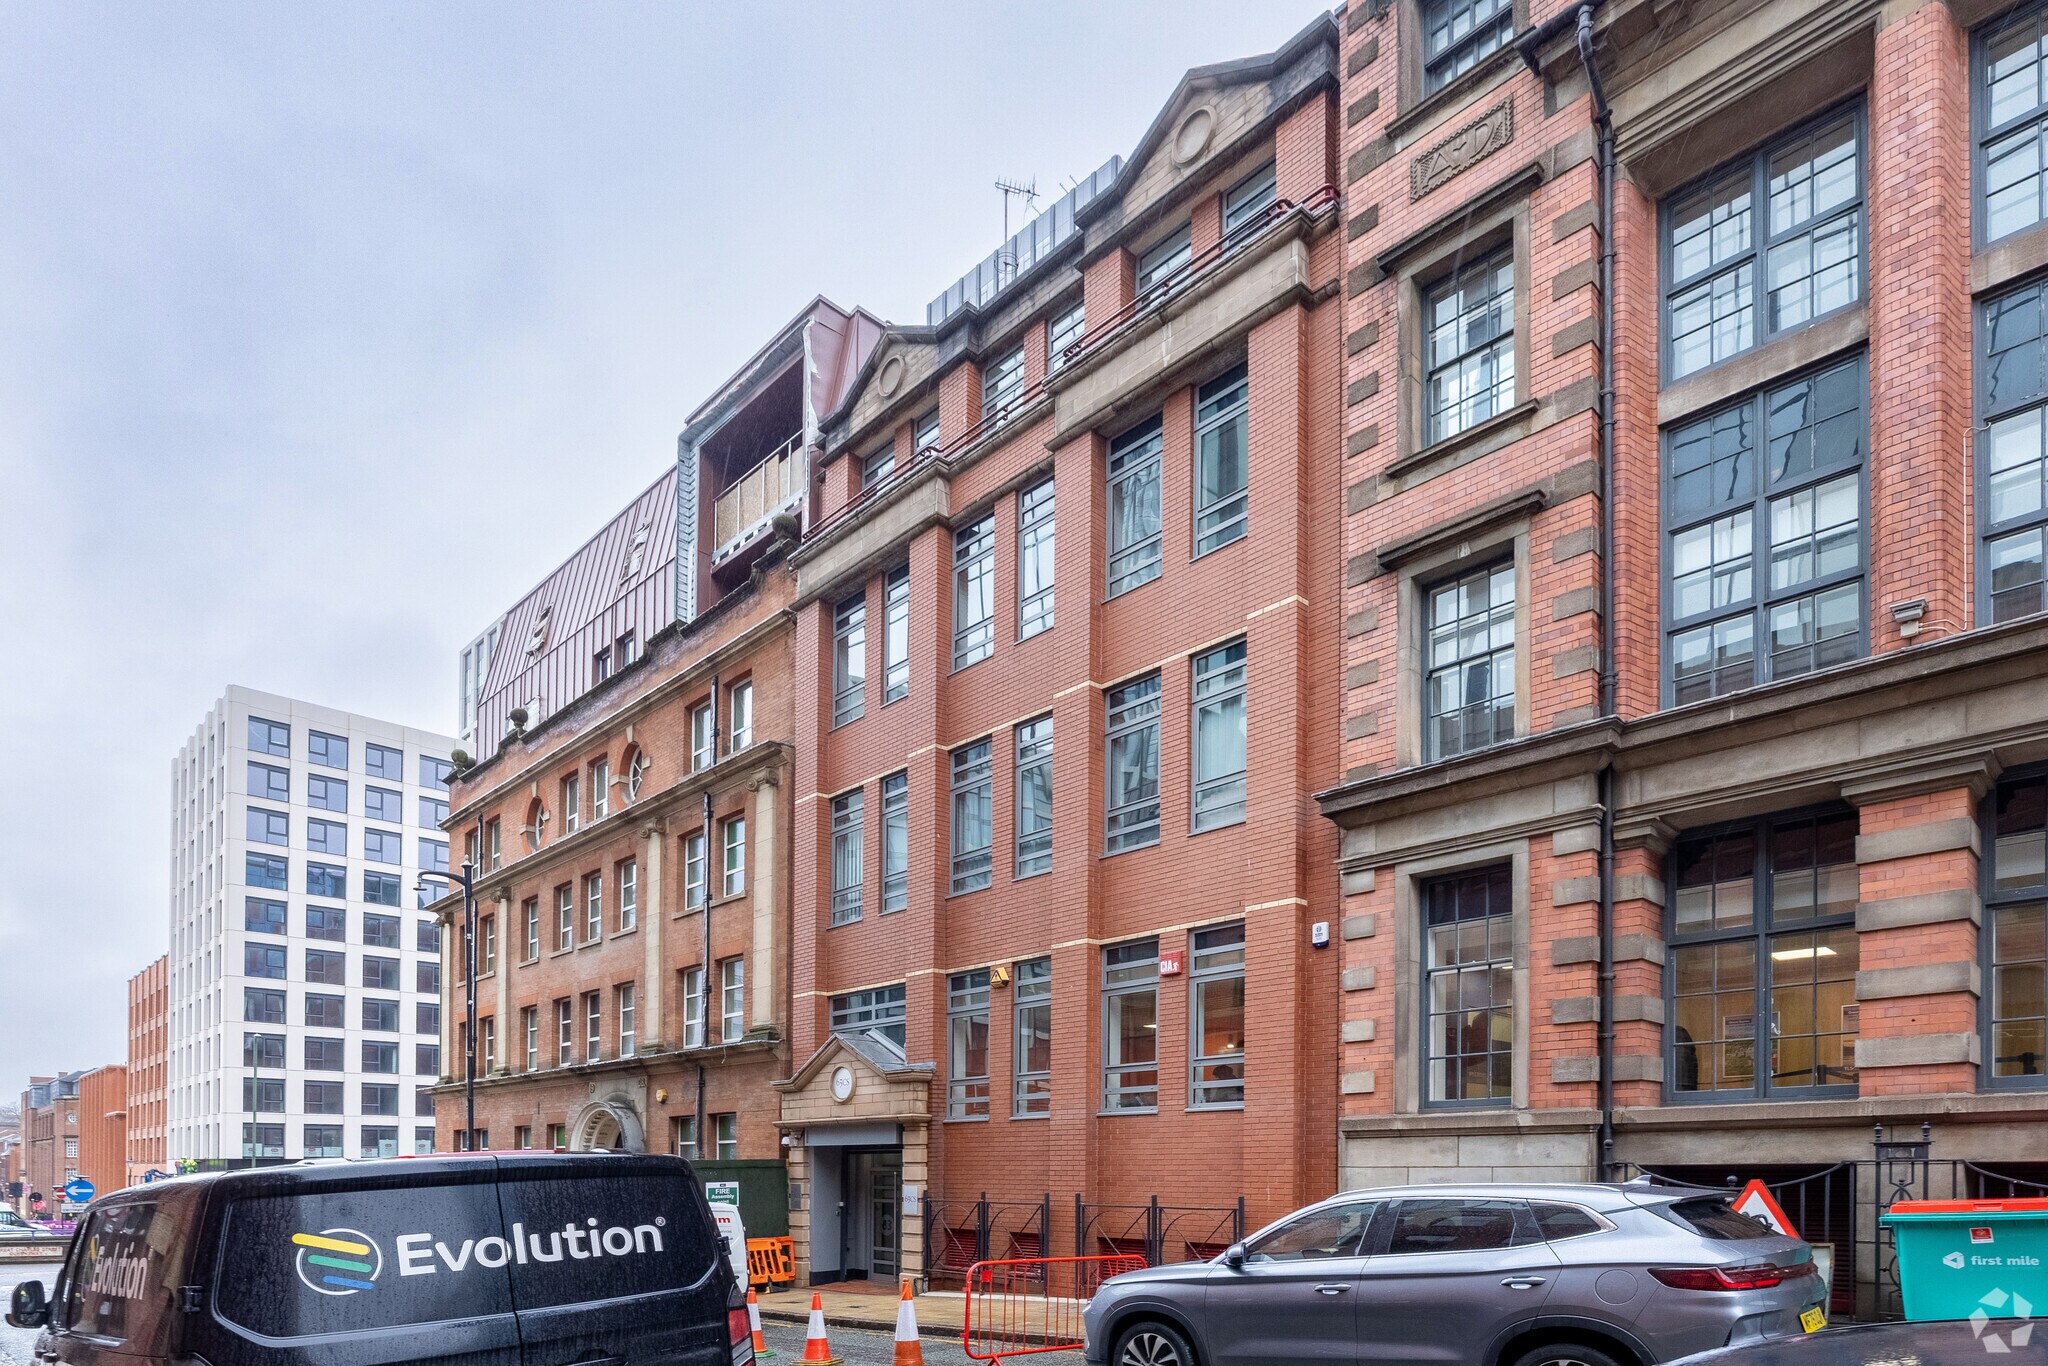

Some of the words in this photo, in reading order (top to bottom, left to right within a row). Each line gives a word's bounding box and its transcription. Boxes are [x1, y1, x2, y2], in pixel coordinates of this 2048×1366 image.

[91, 1242, 148, 1300] Evolution
[1970, 1255, 2002, 1266] first
[2007, 1255, 2040, 1266] mile
